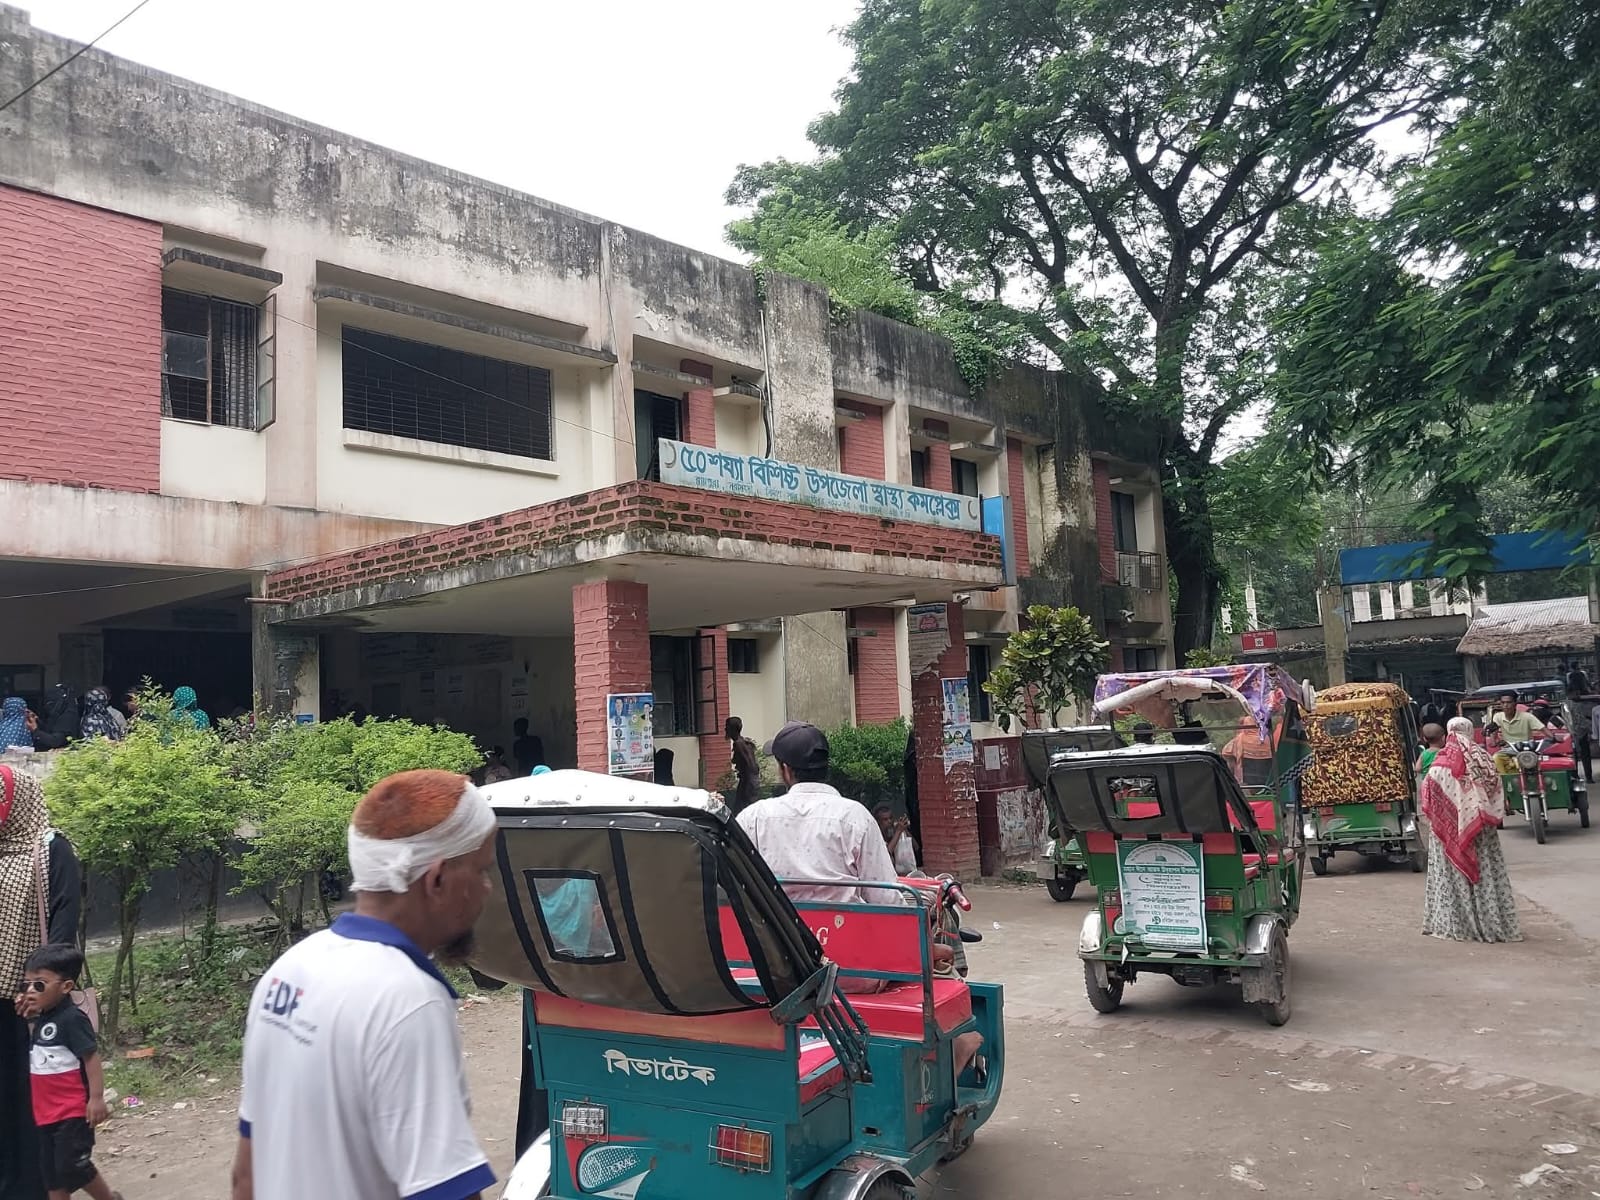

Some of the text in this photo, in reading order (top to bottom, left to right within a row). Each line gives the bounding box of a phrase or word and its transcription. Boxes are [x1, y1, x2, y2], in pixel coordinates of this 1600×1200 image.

[680, 446, 706, 474] ৫০
[706, 453, 744, 481] শয্যা
[748, 456, 800, 490] বিশিষ্ট
[805, 468, 868, 503] উপজেলা
[870, 484, 904, 510] স্বাস্থ্য
[907, 490, 961, 520] কমপ্লেক্স
[602, 1049, 716, 1086] বিভাটেক
